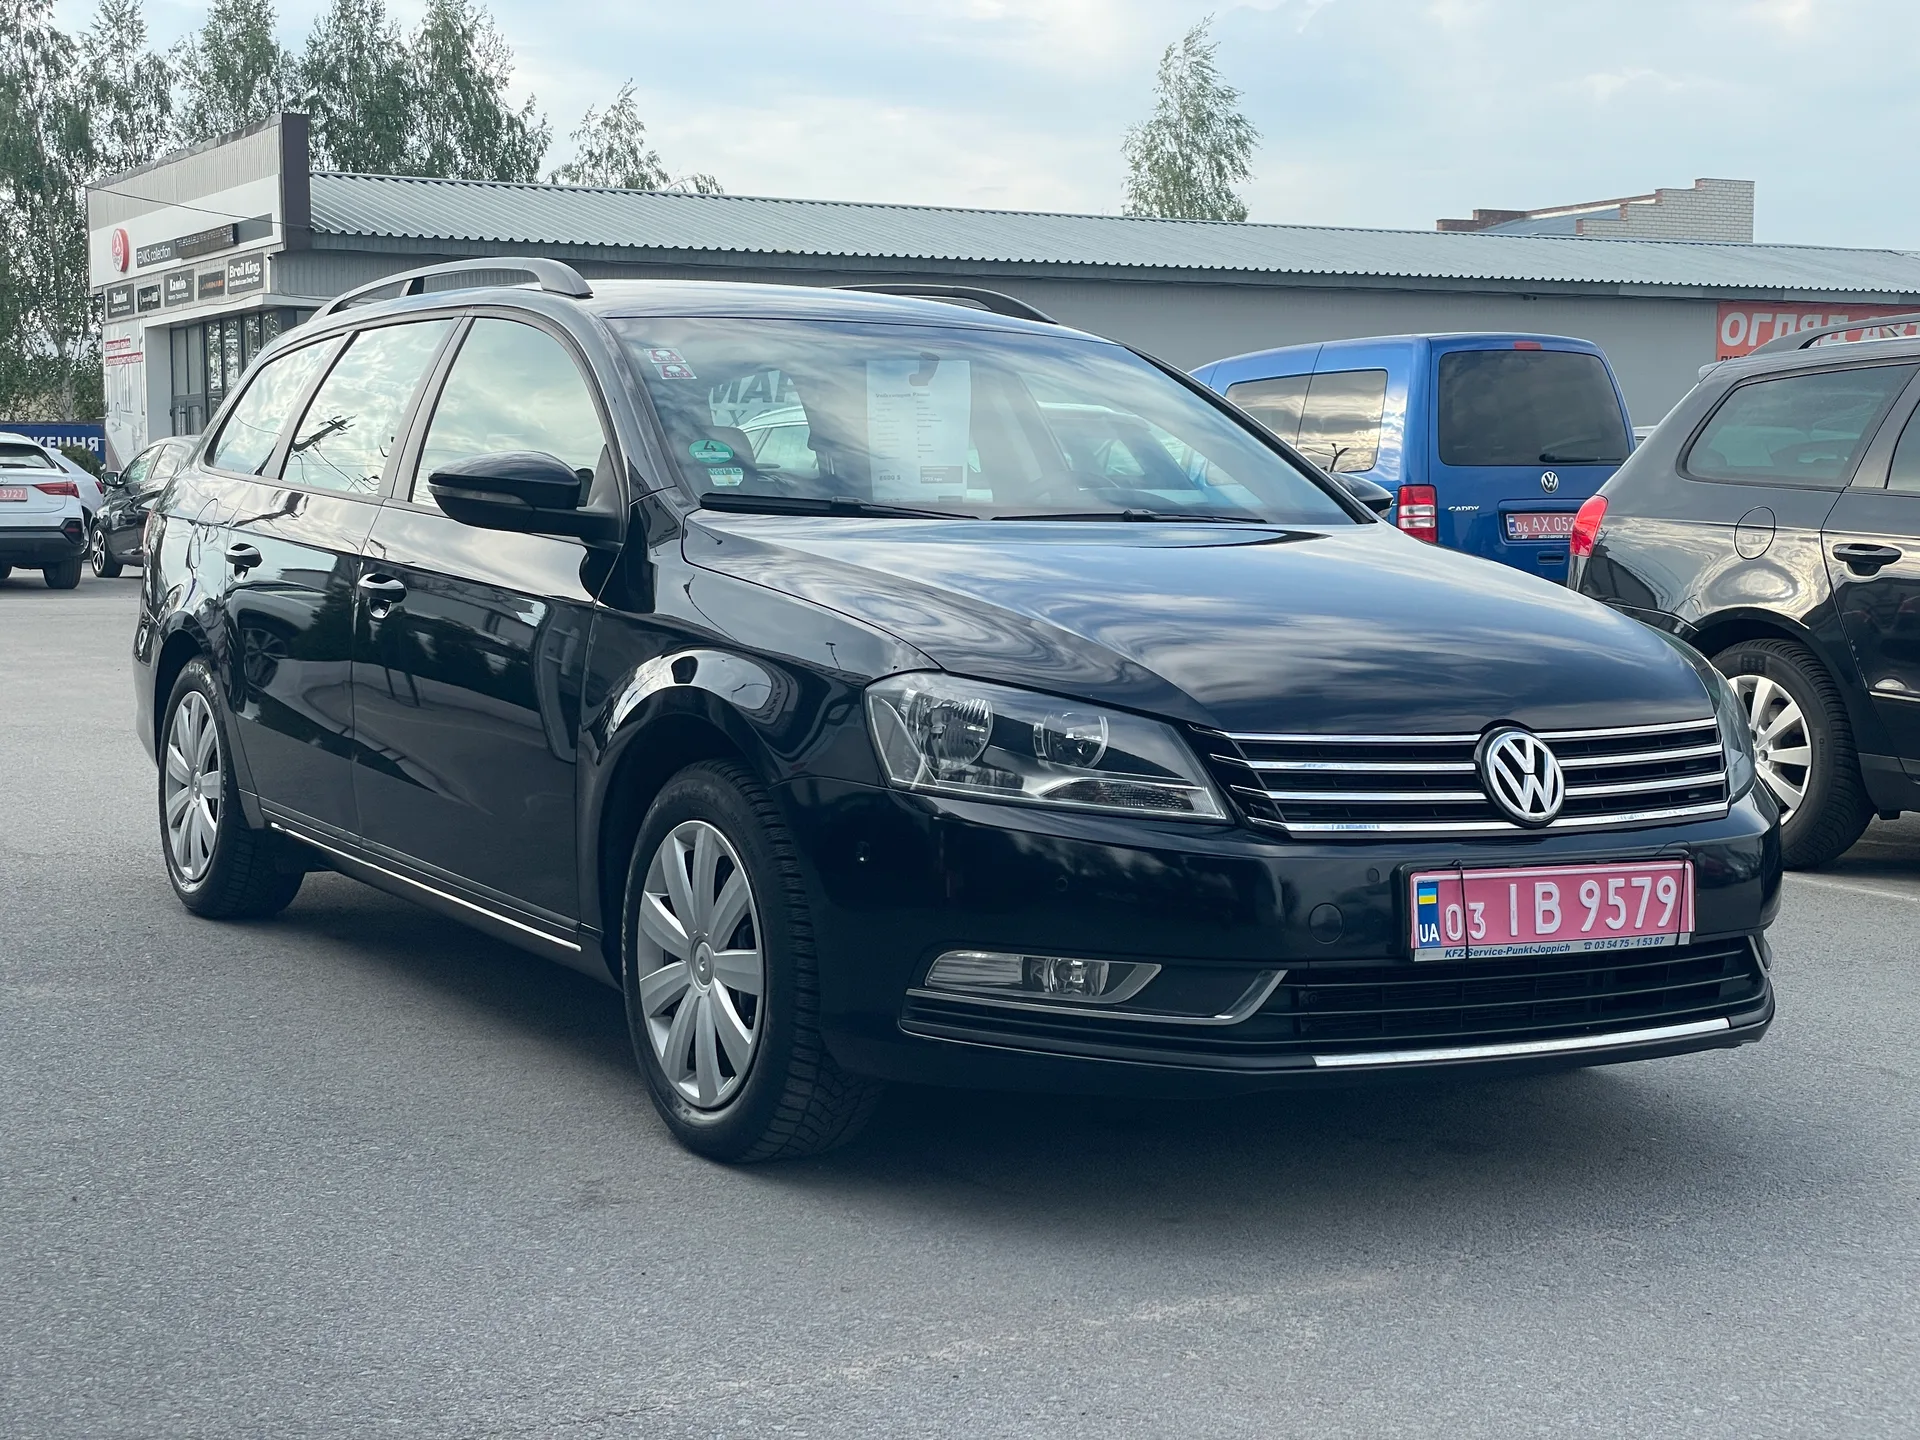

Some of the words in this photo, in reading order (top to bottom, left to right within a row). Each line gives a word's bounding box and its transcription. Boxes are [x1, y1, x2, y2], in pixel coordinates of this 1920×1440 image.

[229, 262, 244, 278] Broil
[245, 260, 261, 275] King
[2, 489, 23, 498] 3727
[1516, 521, 1529, 532] 06
[1532, 516, 1551, 532] AX
[1445, 902, 1487, 941] 03
[1509, 882, 1563, 936] IB
[1579, 876, 1678, 932] 9579
[1419, 923, 1440, 944] UA
